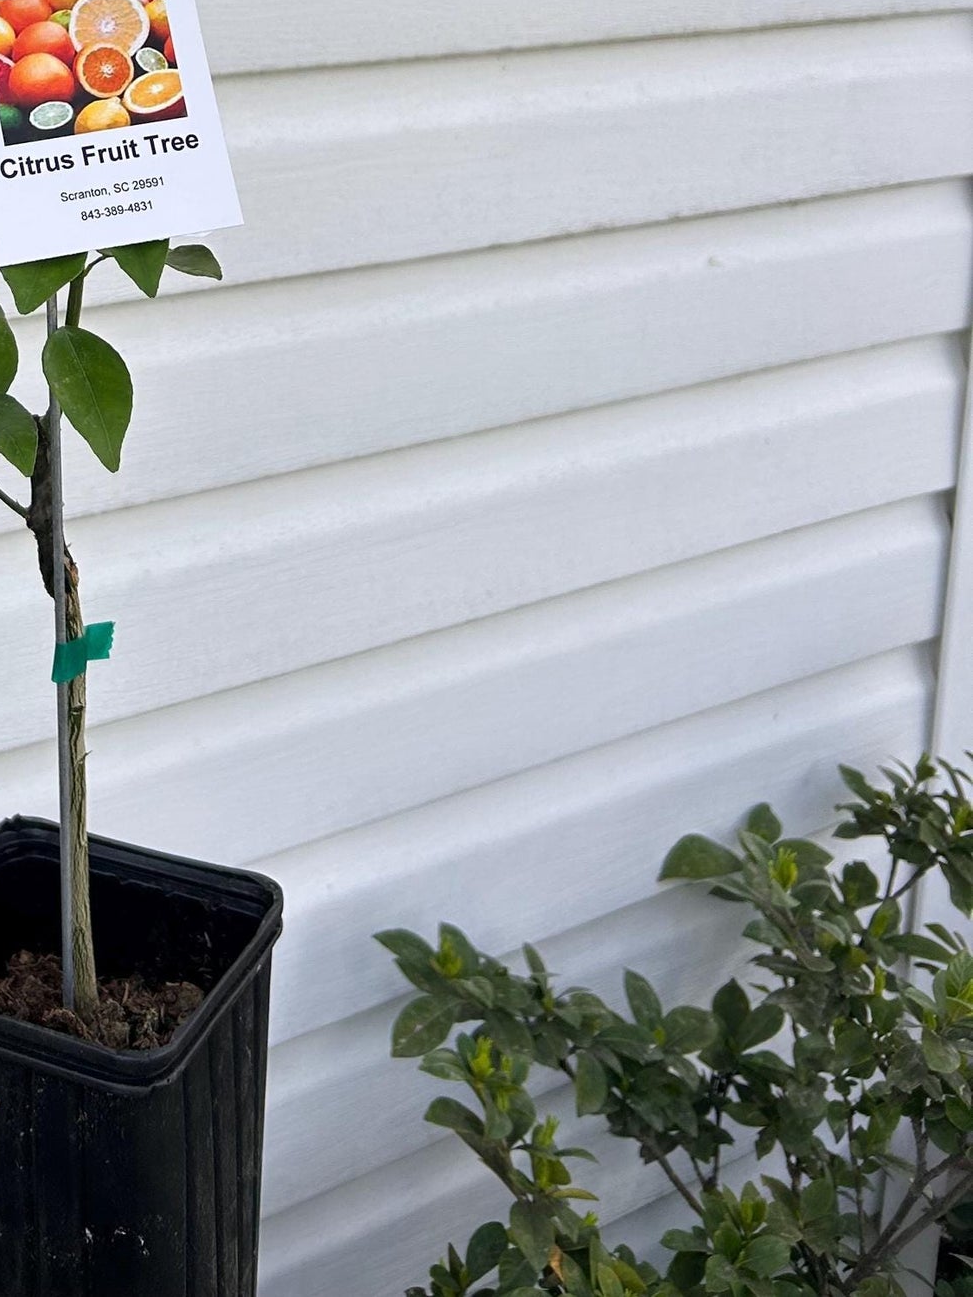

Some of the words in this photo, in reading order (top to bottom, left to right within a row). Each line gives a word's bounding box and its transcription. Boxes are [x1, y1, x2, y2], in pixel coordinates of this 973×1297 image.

[0, 153, 75, 179] Citrus
[81, 139, 140, 166] Fruit
[144, 133, 199, 155] Tree
[60, 185, 111, 202] Scranton,
[113, 181, 130, 194] SC
[132, 176, 165, 192] 29591
[80, 200, 154, 221] 843-389-4831
